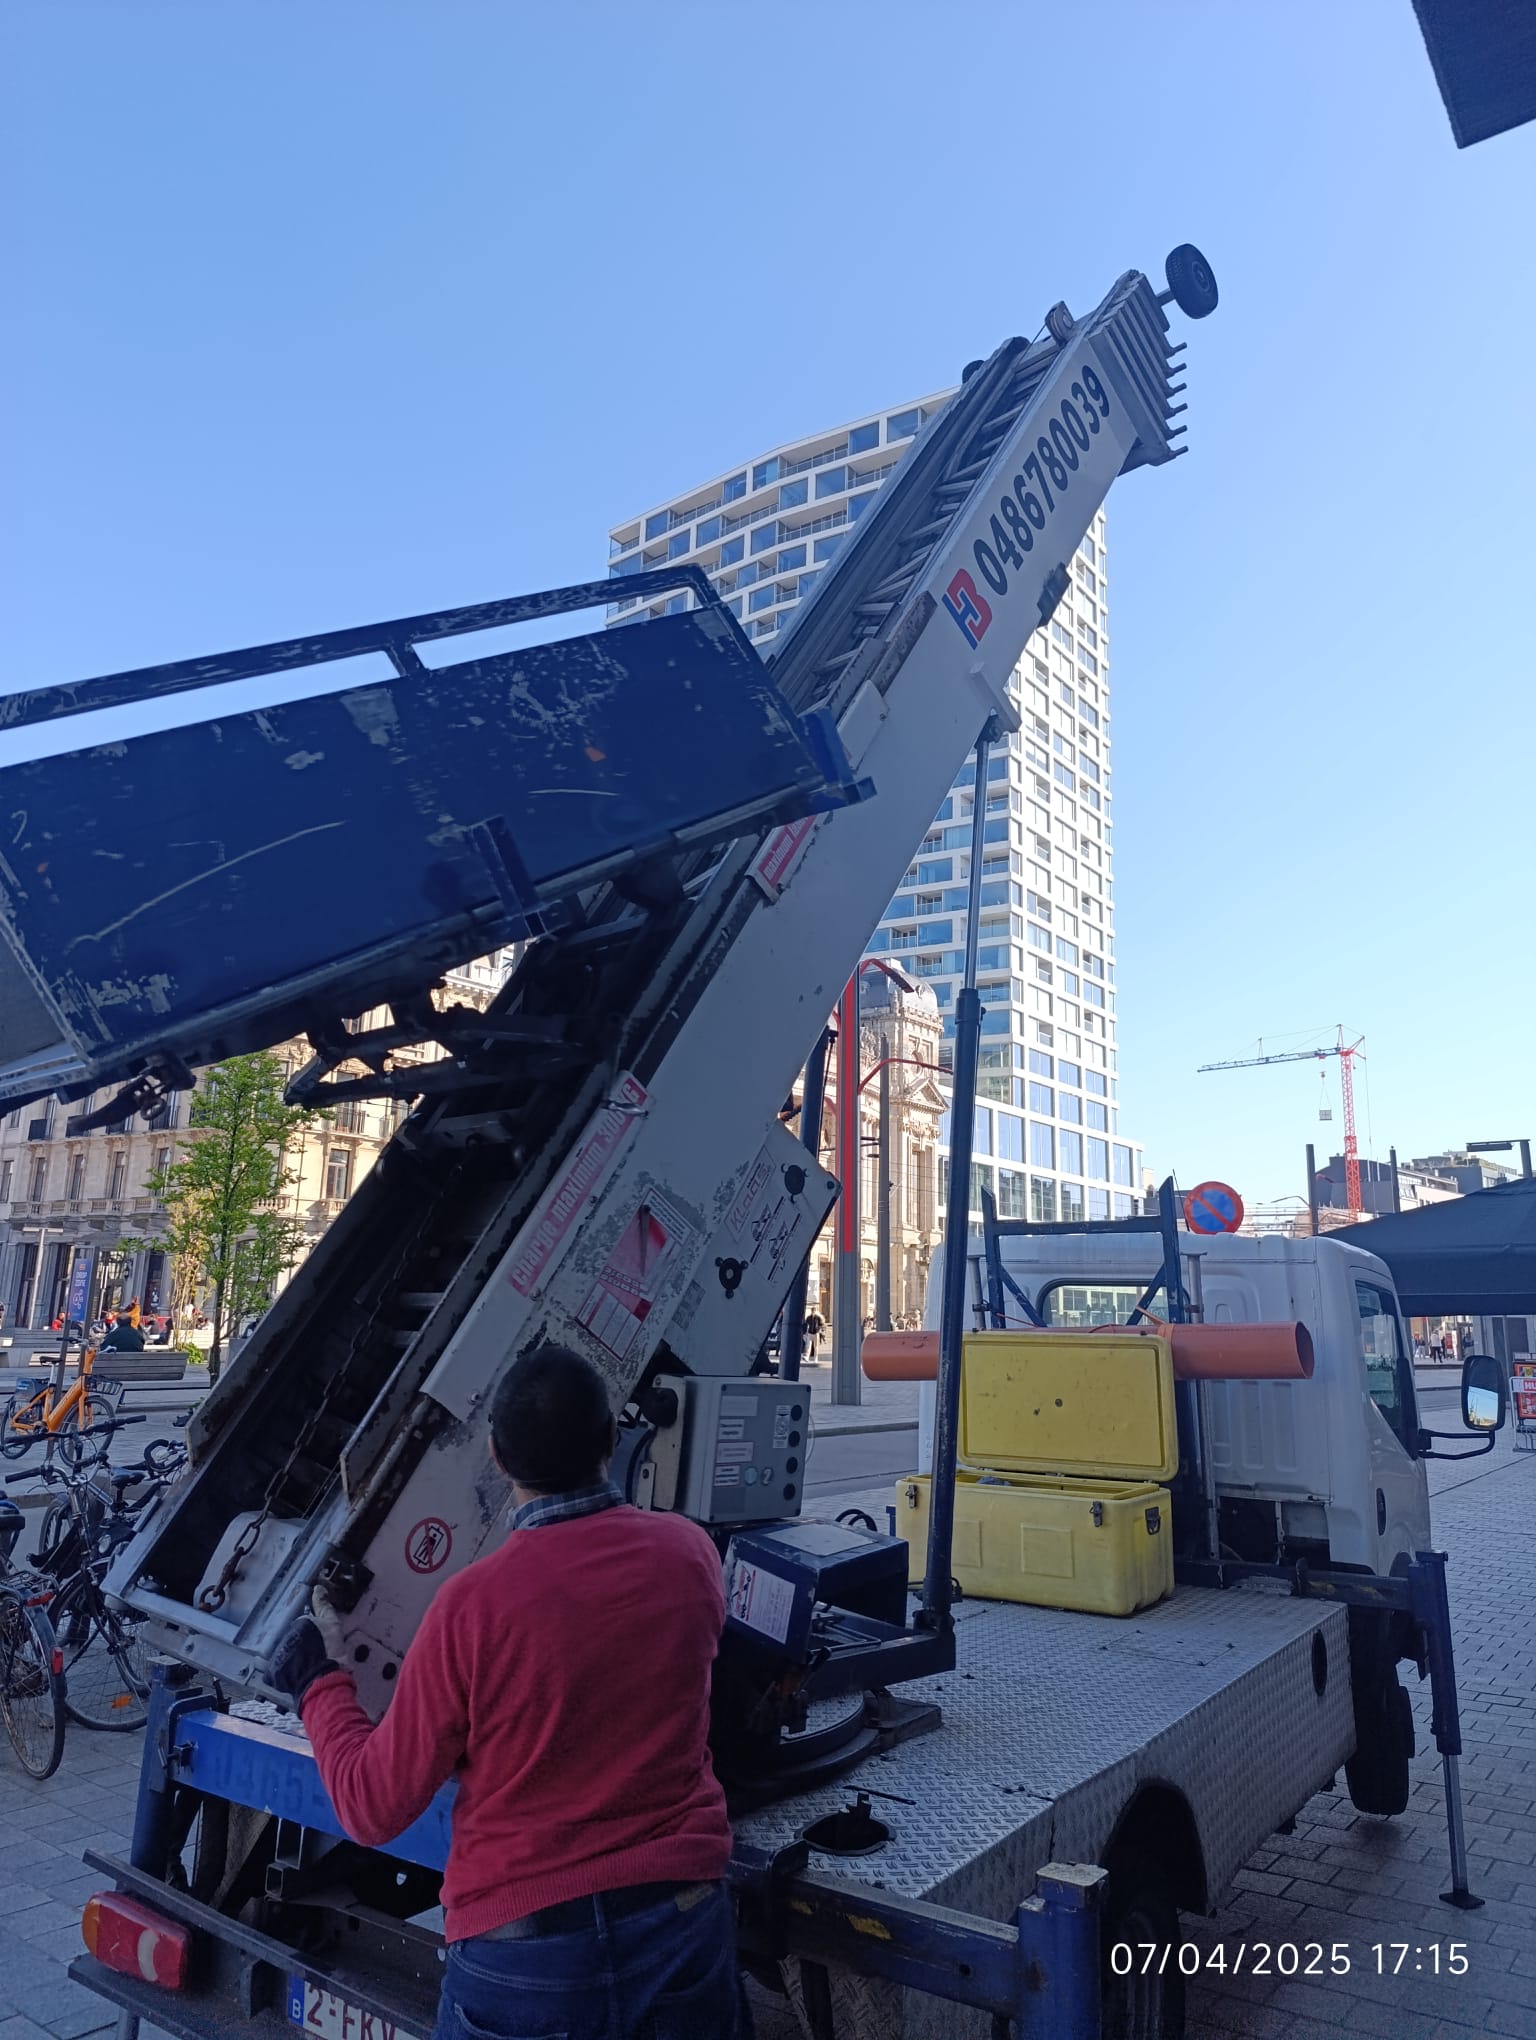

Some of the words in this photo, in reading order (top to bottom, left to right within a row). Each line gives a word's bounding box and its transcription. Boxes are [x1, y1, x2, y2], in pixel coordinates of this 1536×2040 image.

[973, 365, 1110, 596] 0486780039
[552, 1141, 602, 1223] maximum
[292, 1998, 301, 2019] B
